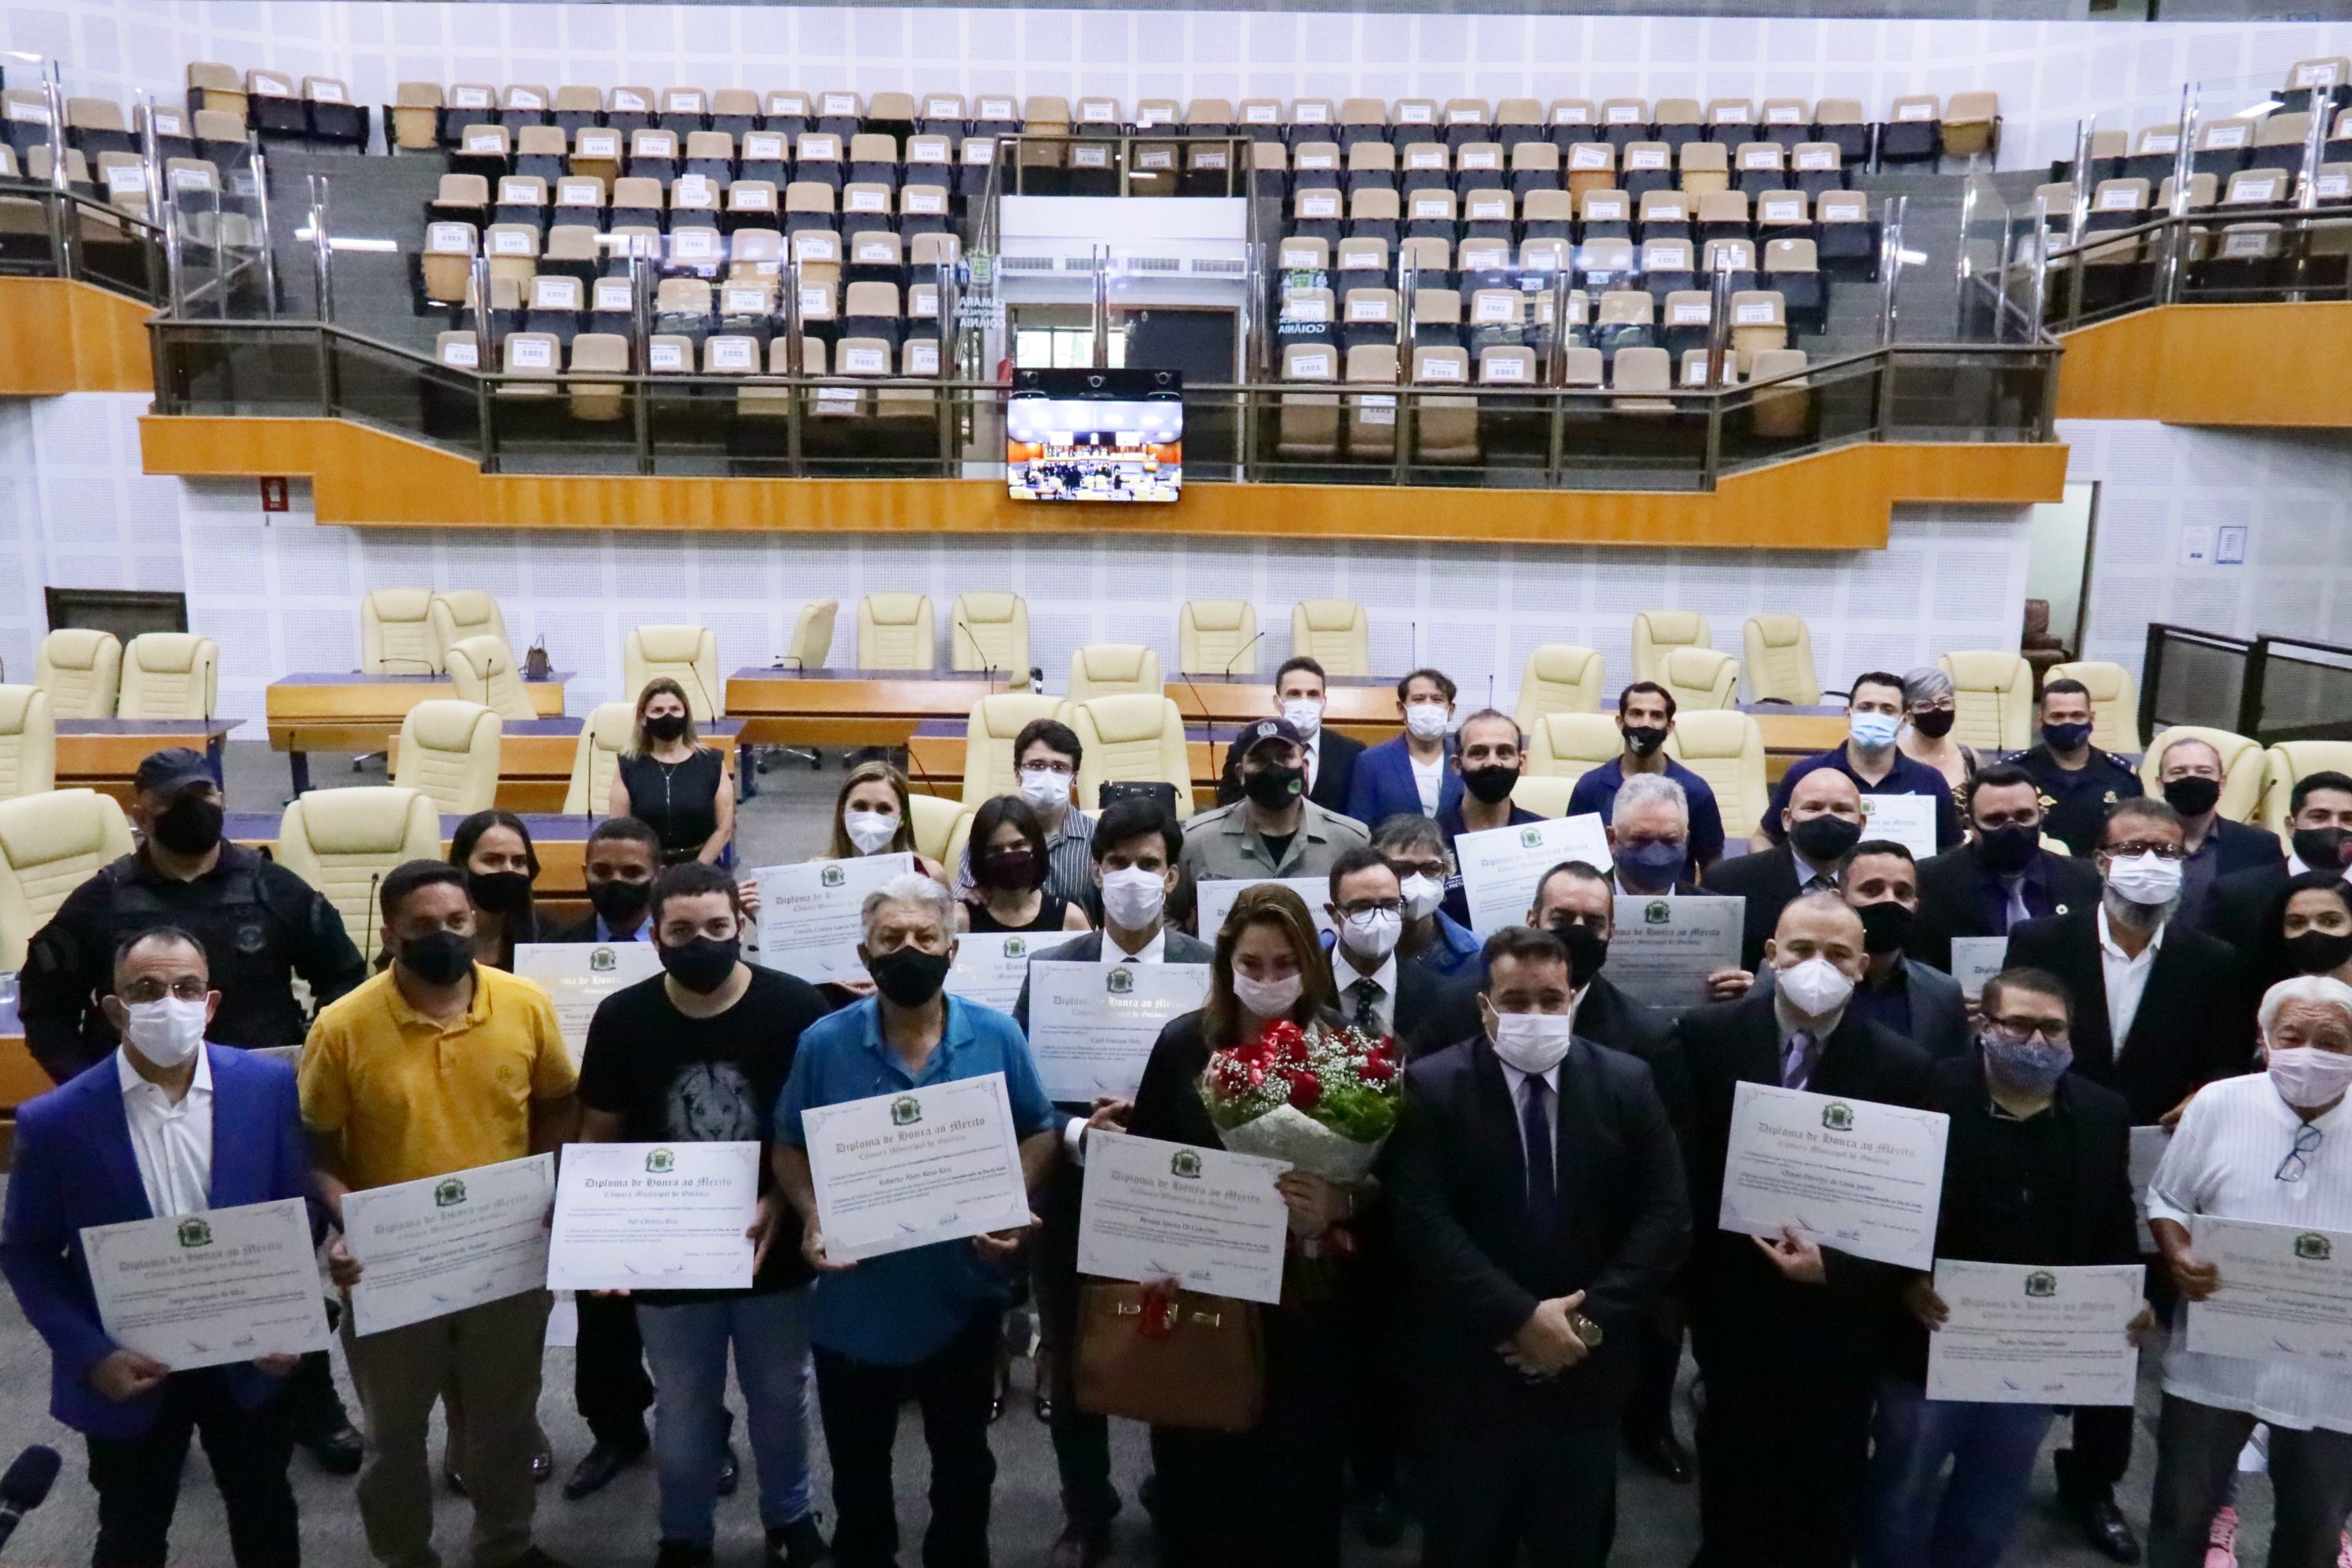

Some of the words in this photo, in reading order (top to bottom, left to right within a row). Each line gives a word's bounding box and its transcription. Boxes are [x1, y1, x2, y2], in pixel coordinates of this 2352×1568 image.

[775, 893, 811, 906] Diploma
[1006, 962, 1027, 971] Honr
[1108, 996, 1138, 1008] Honra
[1140, 998, 1152, 1008] ao
[835, 1136, 880, 1155] Diploma
[883, 1134, 894, 1144] de
[898, 1126, 932, 1142] Honra
[934, 1125, 947, 1134] ao
[948, 1117, 986, 1133] Mérito
[1758, 1121, 1804, 1140] Diploma
[1807, 1130, 1818, 1142] de
[1822, 1133, 1857, 1149] Honra
[1860, 1140, 1873, 1151] ao
[584, 1178, 629, 1189] Diploma
[631, 1178, 643, 1187] de
[646, 1177, 679, 1188] Honra
[681, 1178, 694, 1187] ao
[696, 1175, 733, 1188] Mérito
[878, 1175, 904, 1186] Roberto
[905, 1172, 922, 1182] Alves
[1111, 1169, 1155, 1186] Diploma
[1157, 1178, 1169, 1188] de
[1208, 1188, 1221, 1198] ao
[634, 1190, 670, 1199] Municipal
